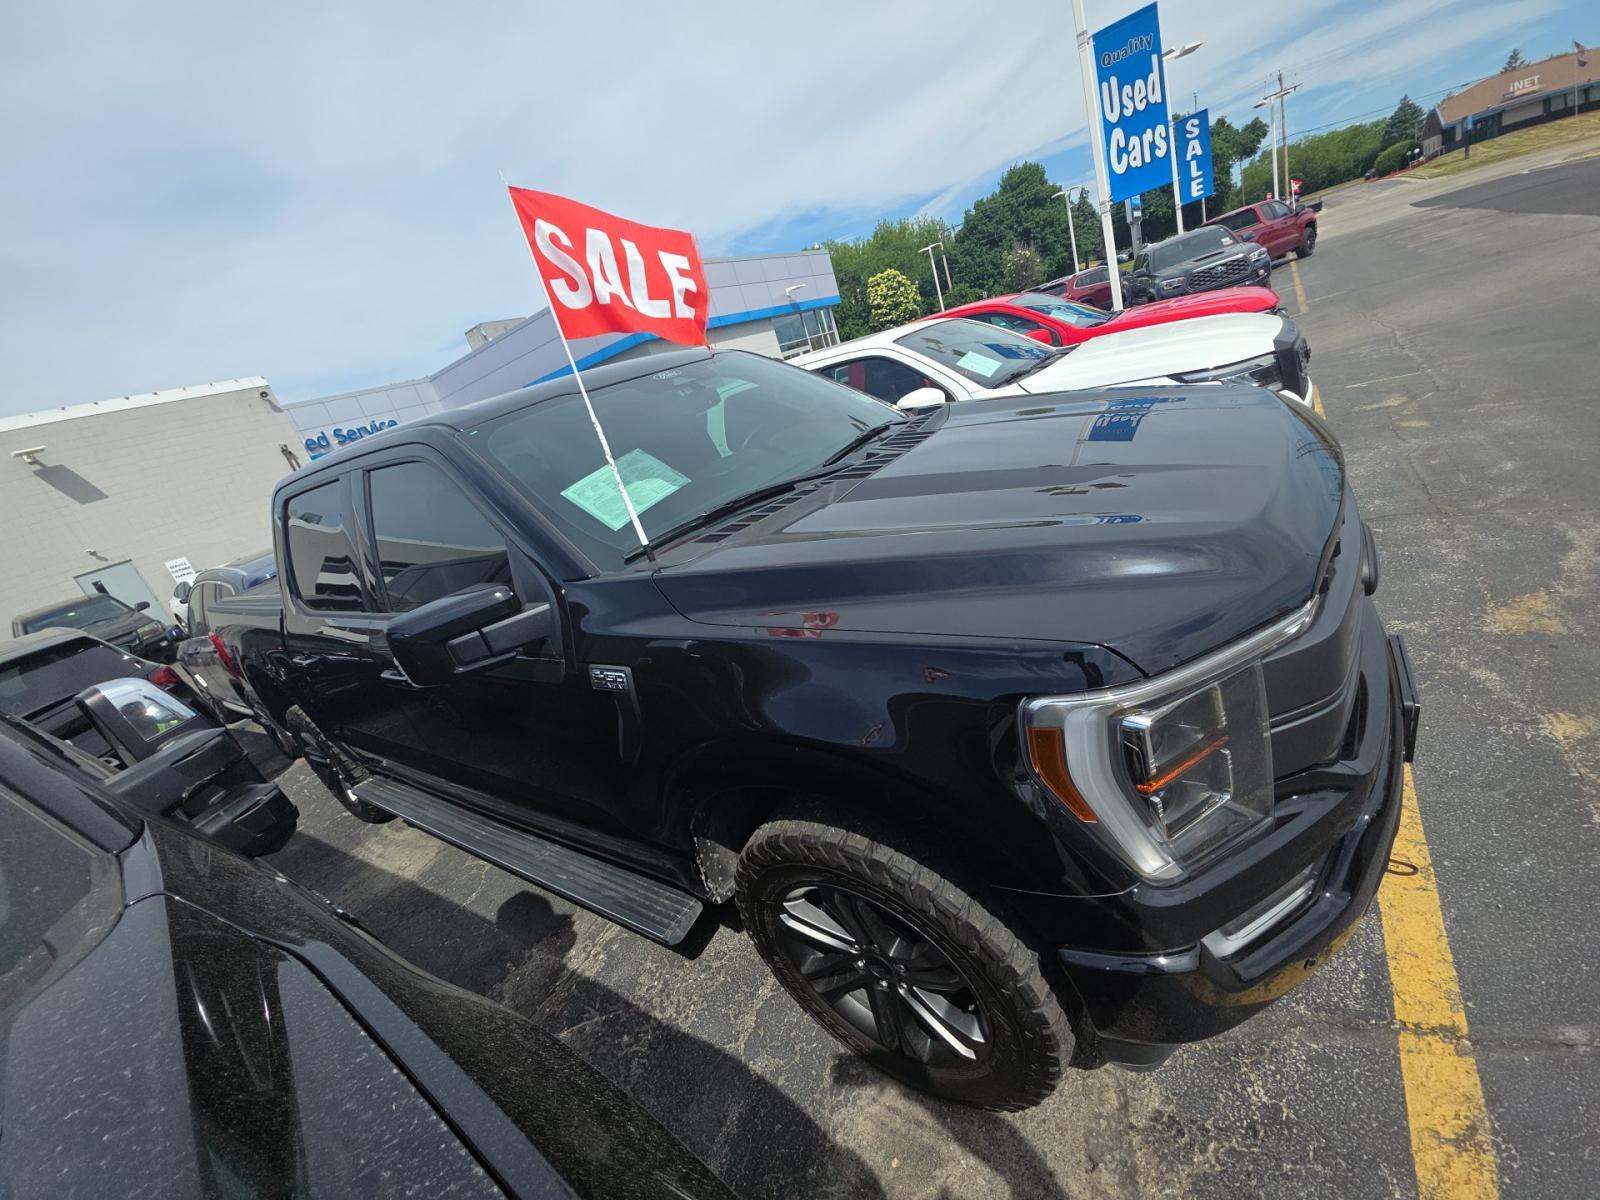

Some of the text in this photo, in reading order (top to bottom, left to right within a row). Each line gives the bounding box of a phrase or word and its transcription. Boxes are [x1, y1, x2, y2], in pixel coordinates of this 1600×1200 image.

[1101, 33, 1153, 67] Quality
[1102, 54, 1162, 123] Used
[1110, 124, 1168, 174] Cars
[1185, 119, 1204, 198] SALE
[535, 218, 697, 320] SALE
